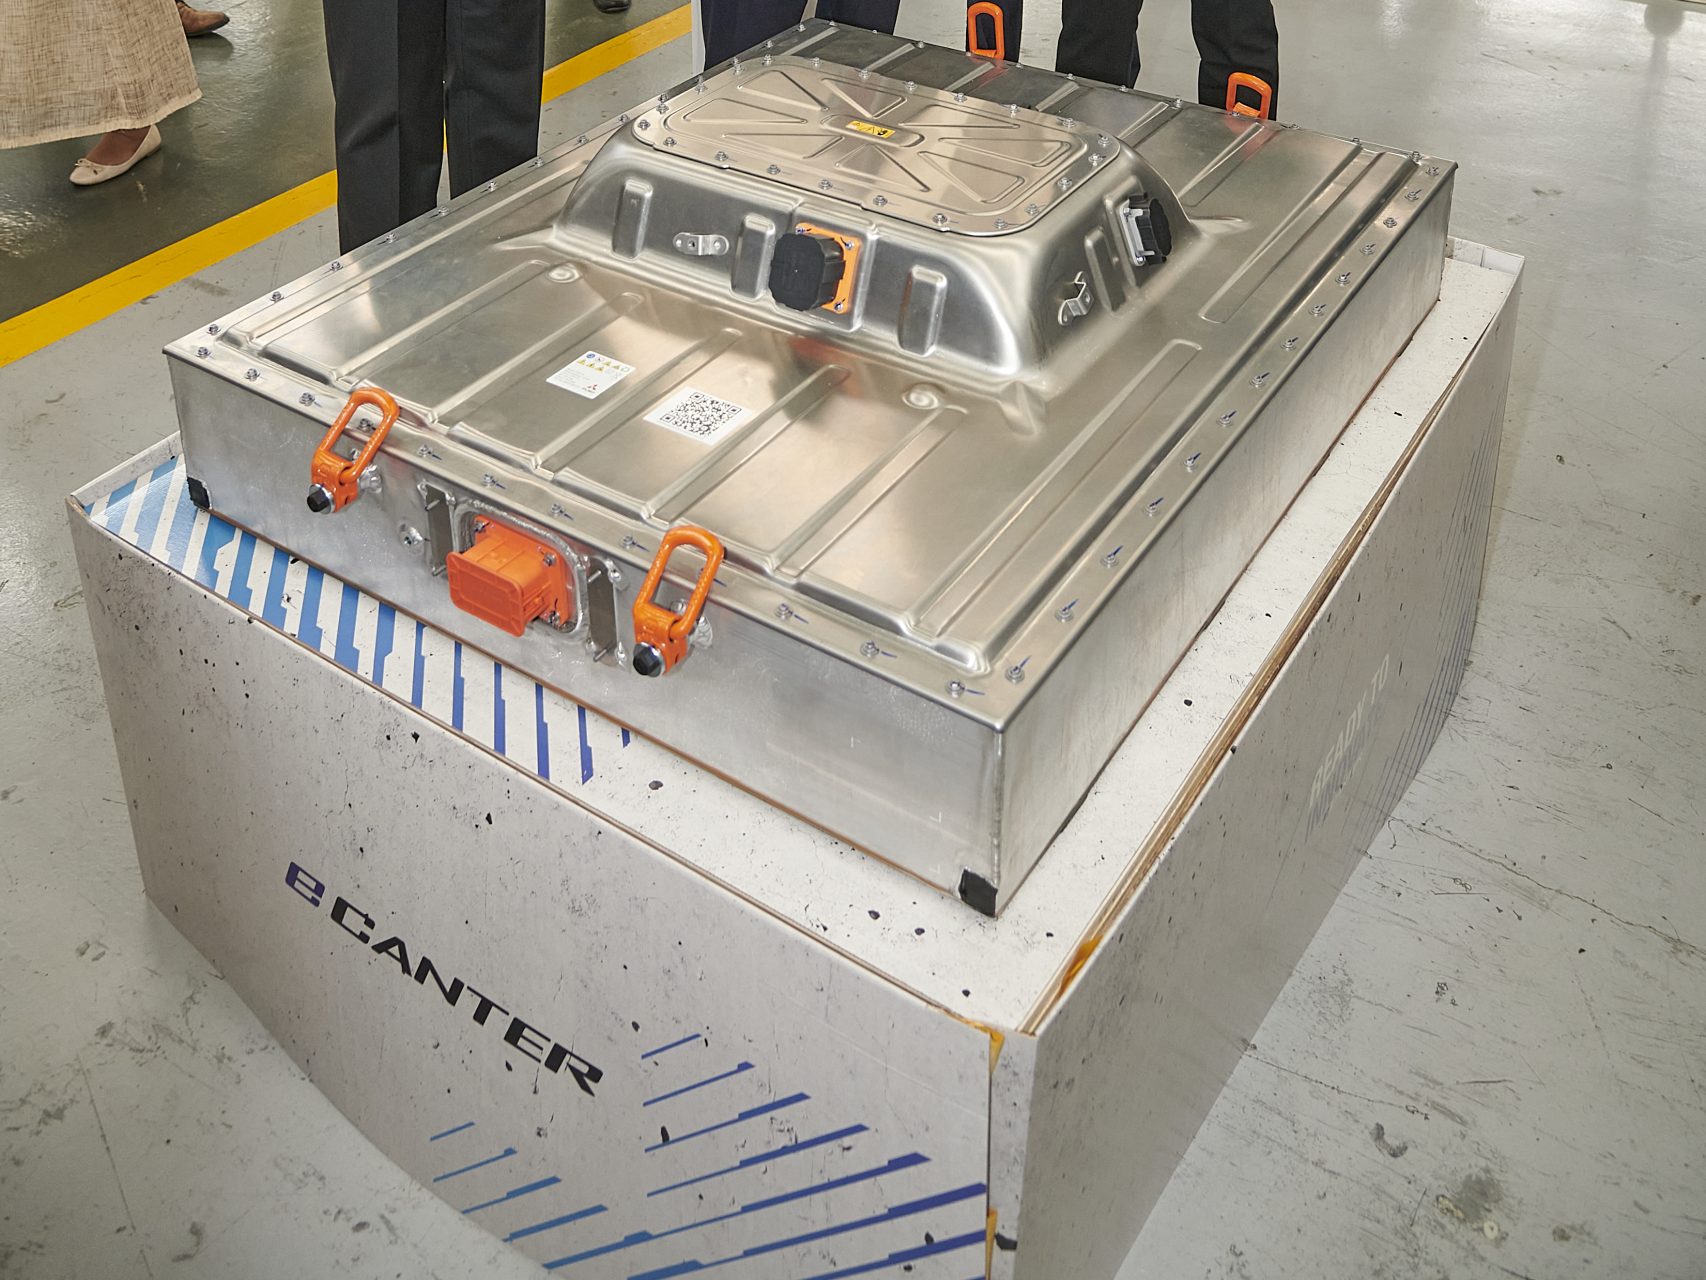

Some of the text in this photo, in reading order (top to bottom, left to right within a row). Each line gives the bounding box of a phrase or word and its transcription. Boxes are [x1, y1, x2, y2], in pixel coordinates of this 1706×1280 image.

[1309, 653, 1390, 809] READY TO
[285, 861, 604, 1098] eCANTER
